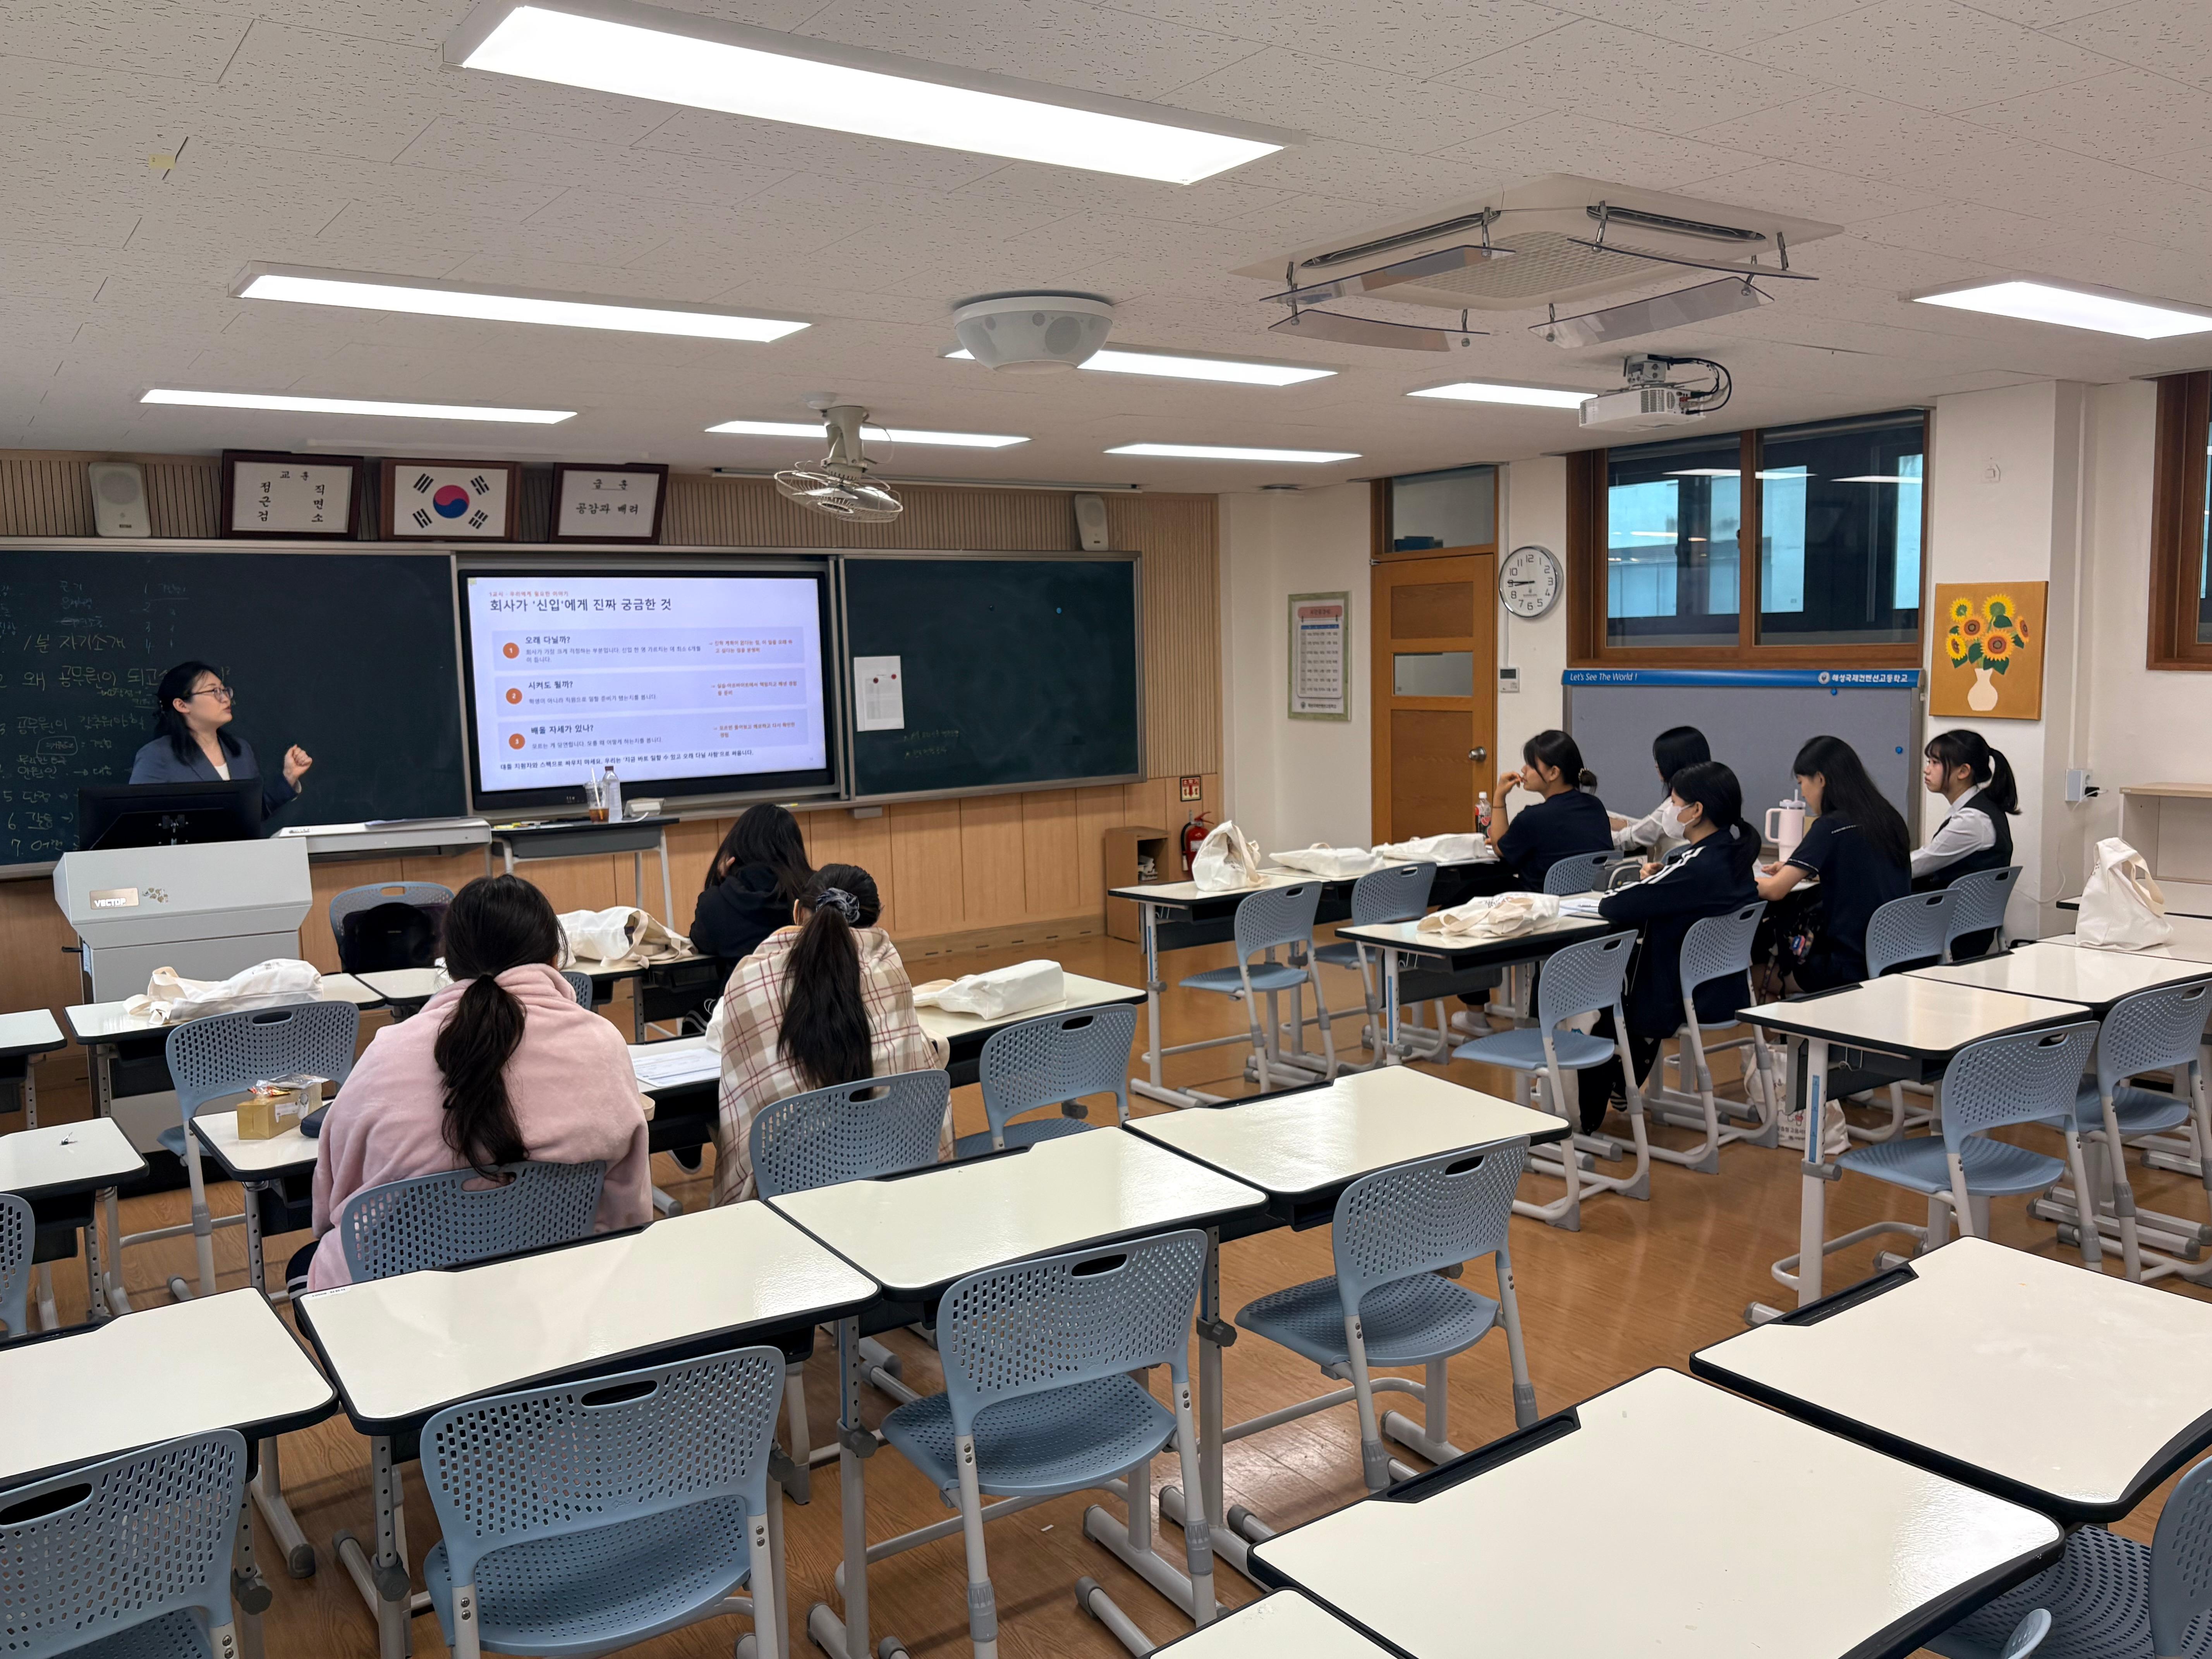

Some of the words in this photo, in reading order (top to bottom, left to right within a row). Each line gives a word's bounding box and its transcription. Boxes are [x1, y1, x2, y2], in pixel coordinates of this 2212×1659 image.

[259, 496, 271, 507] 근
[313, 498, 323, 510] 면
[576, 503, 611, 514] 공감과
[618, 504, 638, 514] 배려
[258, 511, 268, 521] 검
[311, 514, 323, 522] 소
[1526, 555, 1534, 563] 12
[1510, 568, 1517, 576] 10
[1544, 565, 1550, 574] 2
[1508, 579, 1514, 587] 9
[1548, 577, 1553, 586] 3
[1511, 591, 1516, 599] 8
[490, 599, 528, 612] 회사가
[593, 598, 617, 611] 진짜
[621, 598, 656, 611] 궁금한
[661, 598, 671, 611] 것
[1518, 599, 1524, 608] 7
[1527, 602, 1533, 610] 6
[1537, 599, 1543, 607] 5
[59, 633, 126, 651] 자기소개
[22, 672, 46, 691] 왜
[58, 665, 116, 689] 공무원이
[1570, 673, 1584, 681] Let's
[1586, 673, 1597, 681] See
[1599, 673, 1611, 681] The
[1613, 673, 1632, 681] World
[529, 681, 551, 690] 시켜도
[554, 680, 573, 689] 될까?
[17, 716, 67, 735] 공무원이
[549, 725, 572, 734] 자세가
[575, 724, 594, 733] 있나?
[3, 790, 12, 802] 5
